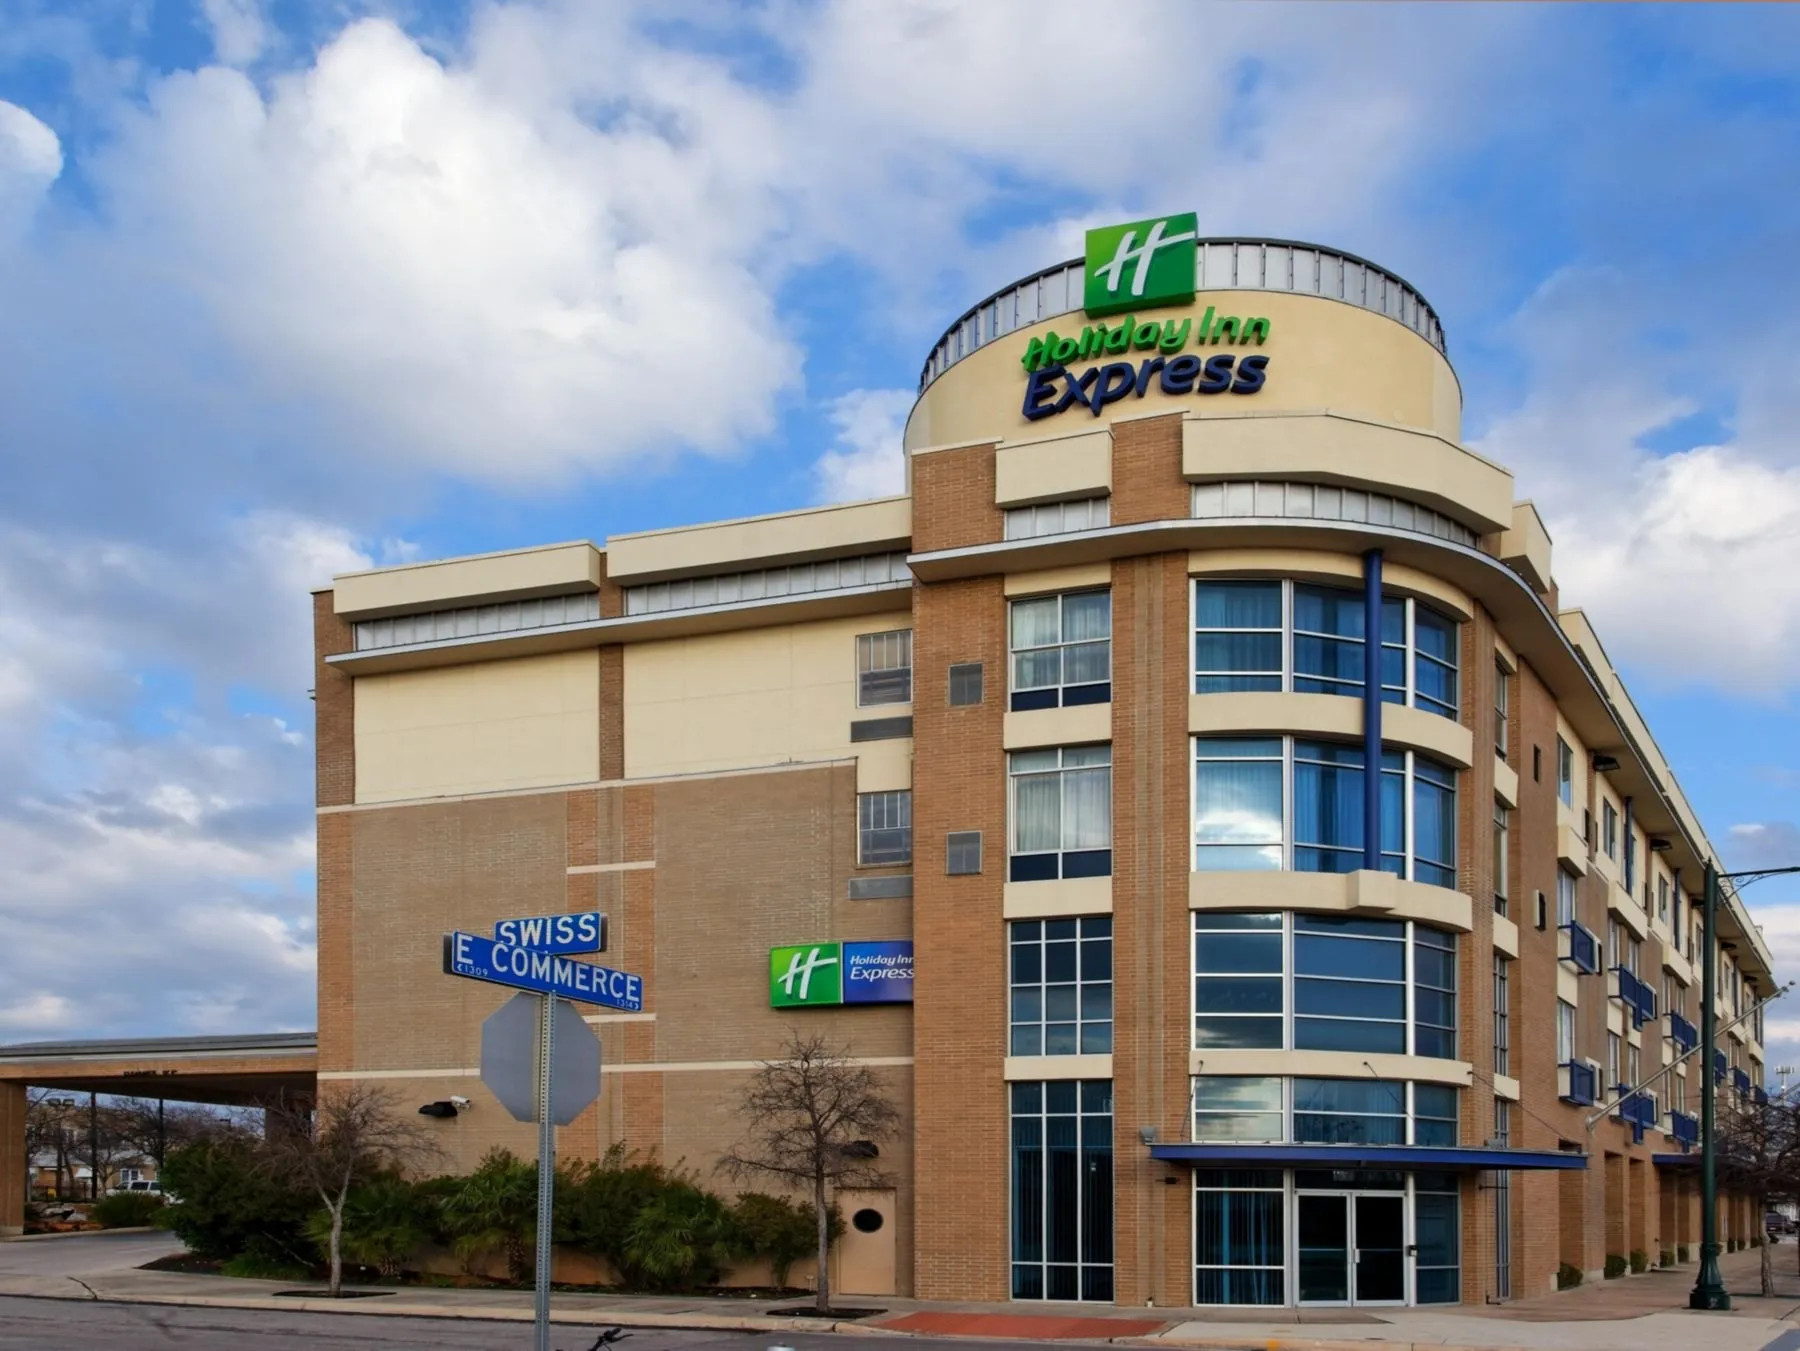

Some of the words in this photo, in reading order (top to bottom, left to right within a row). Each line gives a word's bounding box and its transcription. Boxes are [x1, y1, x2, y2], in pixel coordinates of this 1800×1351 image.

[1021, 313, 1192, 373] Holiday
[1198, 306, 1271, 346] Inn
[1022, 354, 1271, 421] Express
[499, 913, 597, 947] SWISS
[456, 935, 474, 965] E
[491, 943, 640, 1002] COMMERCE
[850, 954, 896, 967] Holiday
[850, 966, 915, 983] Express
